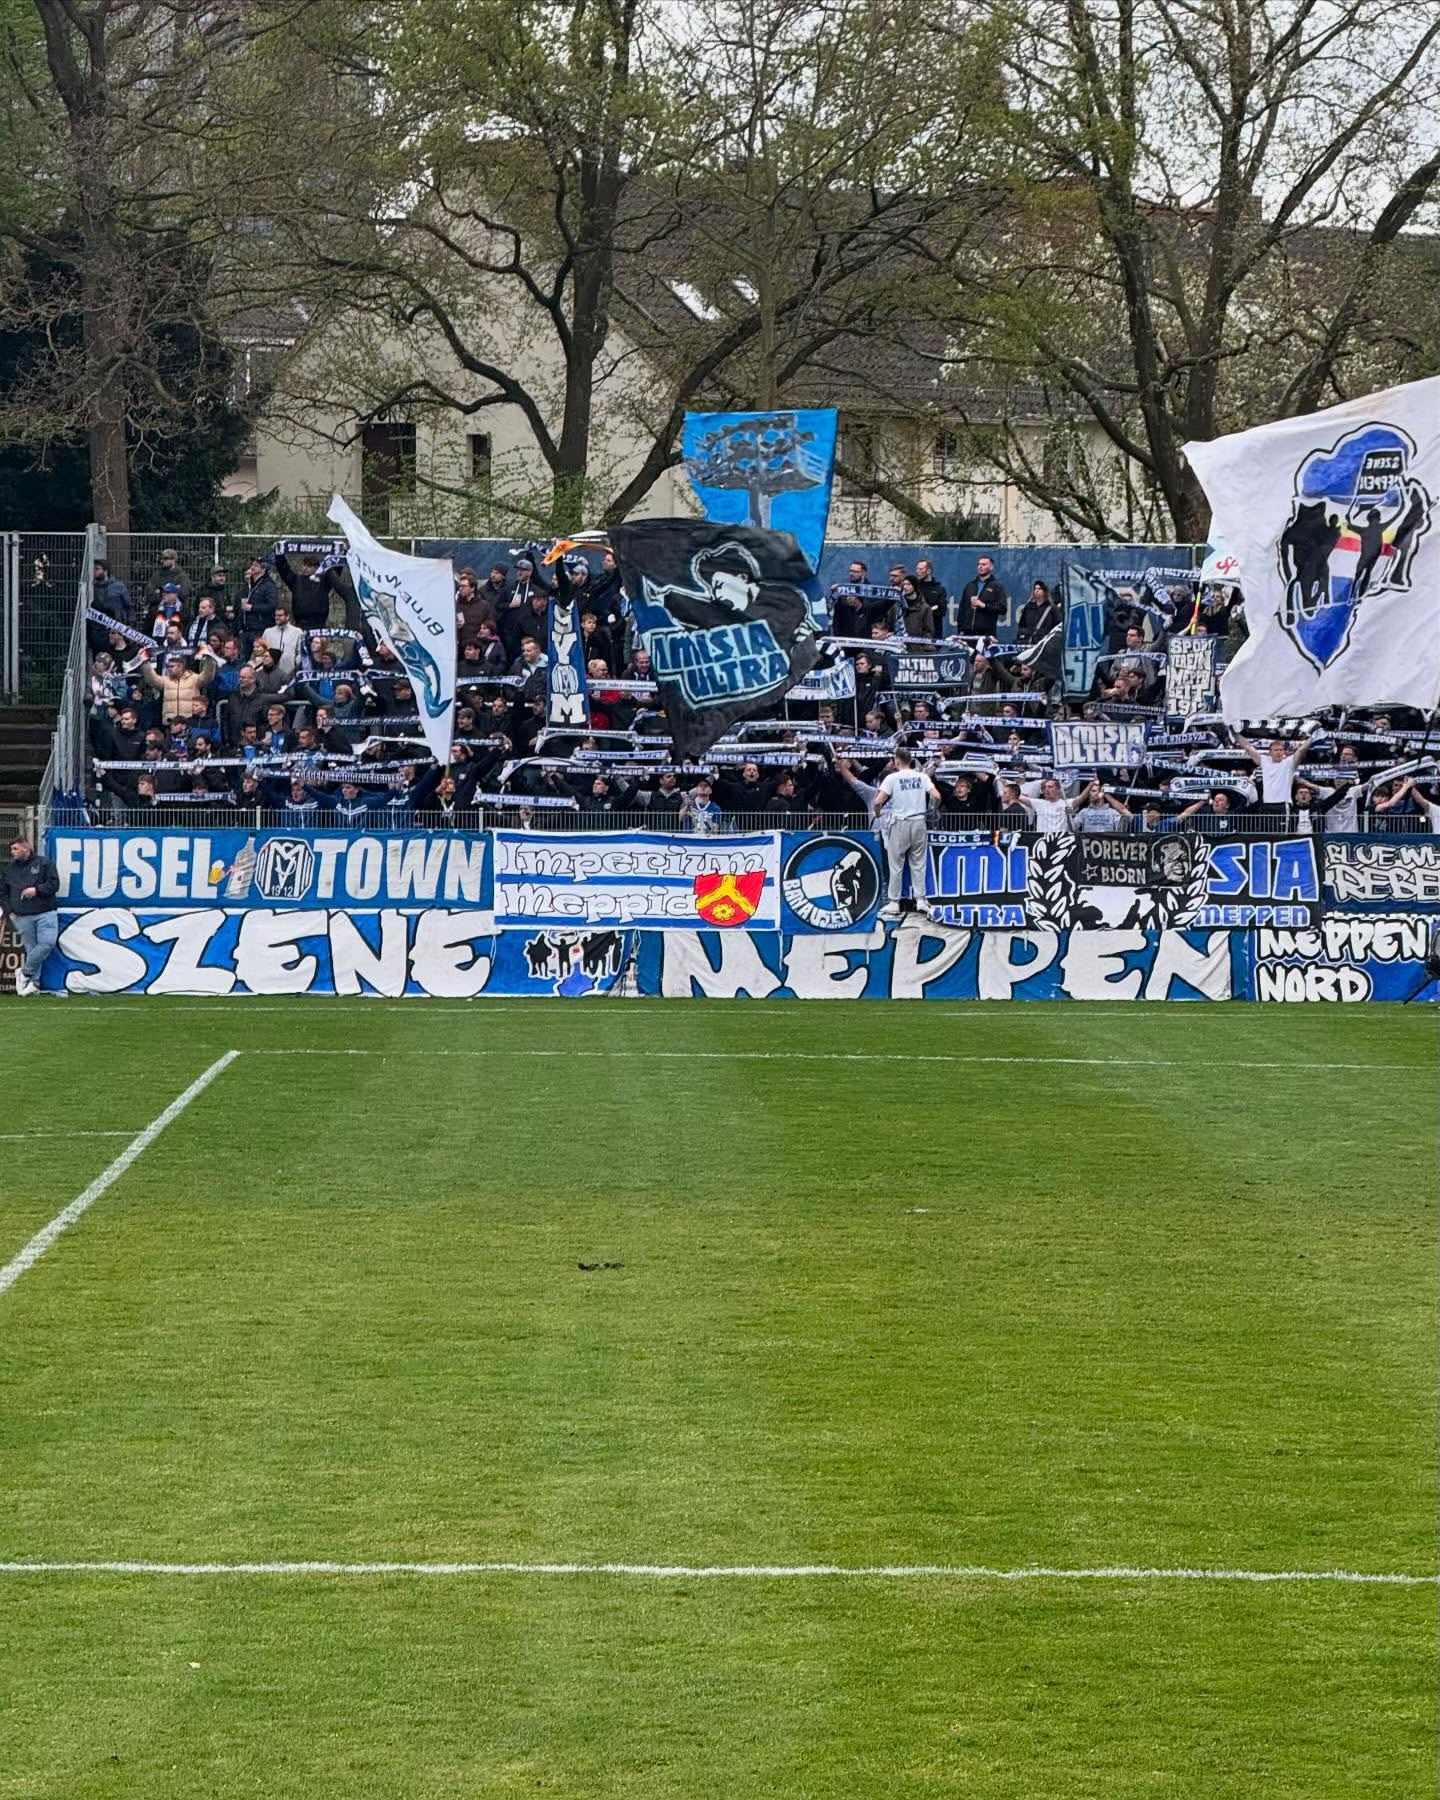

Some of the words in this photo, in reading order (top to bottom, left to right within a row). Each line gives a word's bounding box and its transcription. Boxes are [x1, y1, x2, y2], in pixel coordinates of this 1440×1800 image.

[287, 543, 298, 552] SV
[300, 544, 333, 552] MEPPEN
[684, 650, 790, 701] ULTRA
[1055, 726, 1144, 744] AMISIA
[1056, 743, 1128, 763] ULTRA
[499, 841, 767, 883] Imperium
[1081, 837, 1148, 862] FOREVER
[56, 837, 219, 899] FUSEL
[313, 838, 482, 903] TOWN
[1100, 865, 1147, 884] BJÖRN
[1325, 864, 1440, 903] REBE
[1195, 906, 1311, 928] MEPPEN
[57, 908, 493, 998] SZENE
[1257, 918, 1429, 963] MEPPEN
[1257, 962, 1371, 1003] NORD
